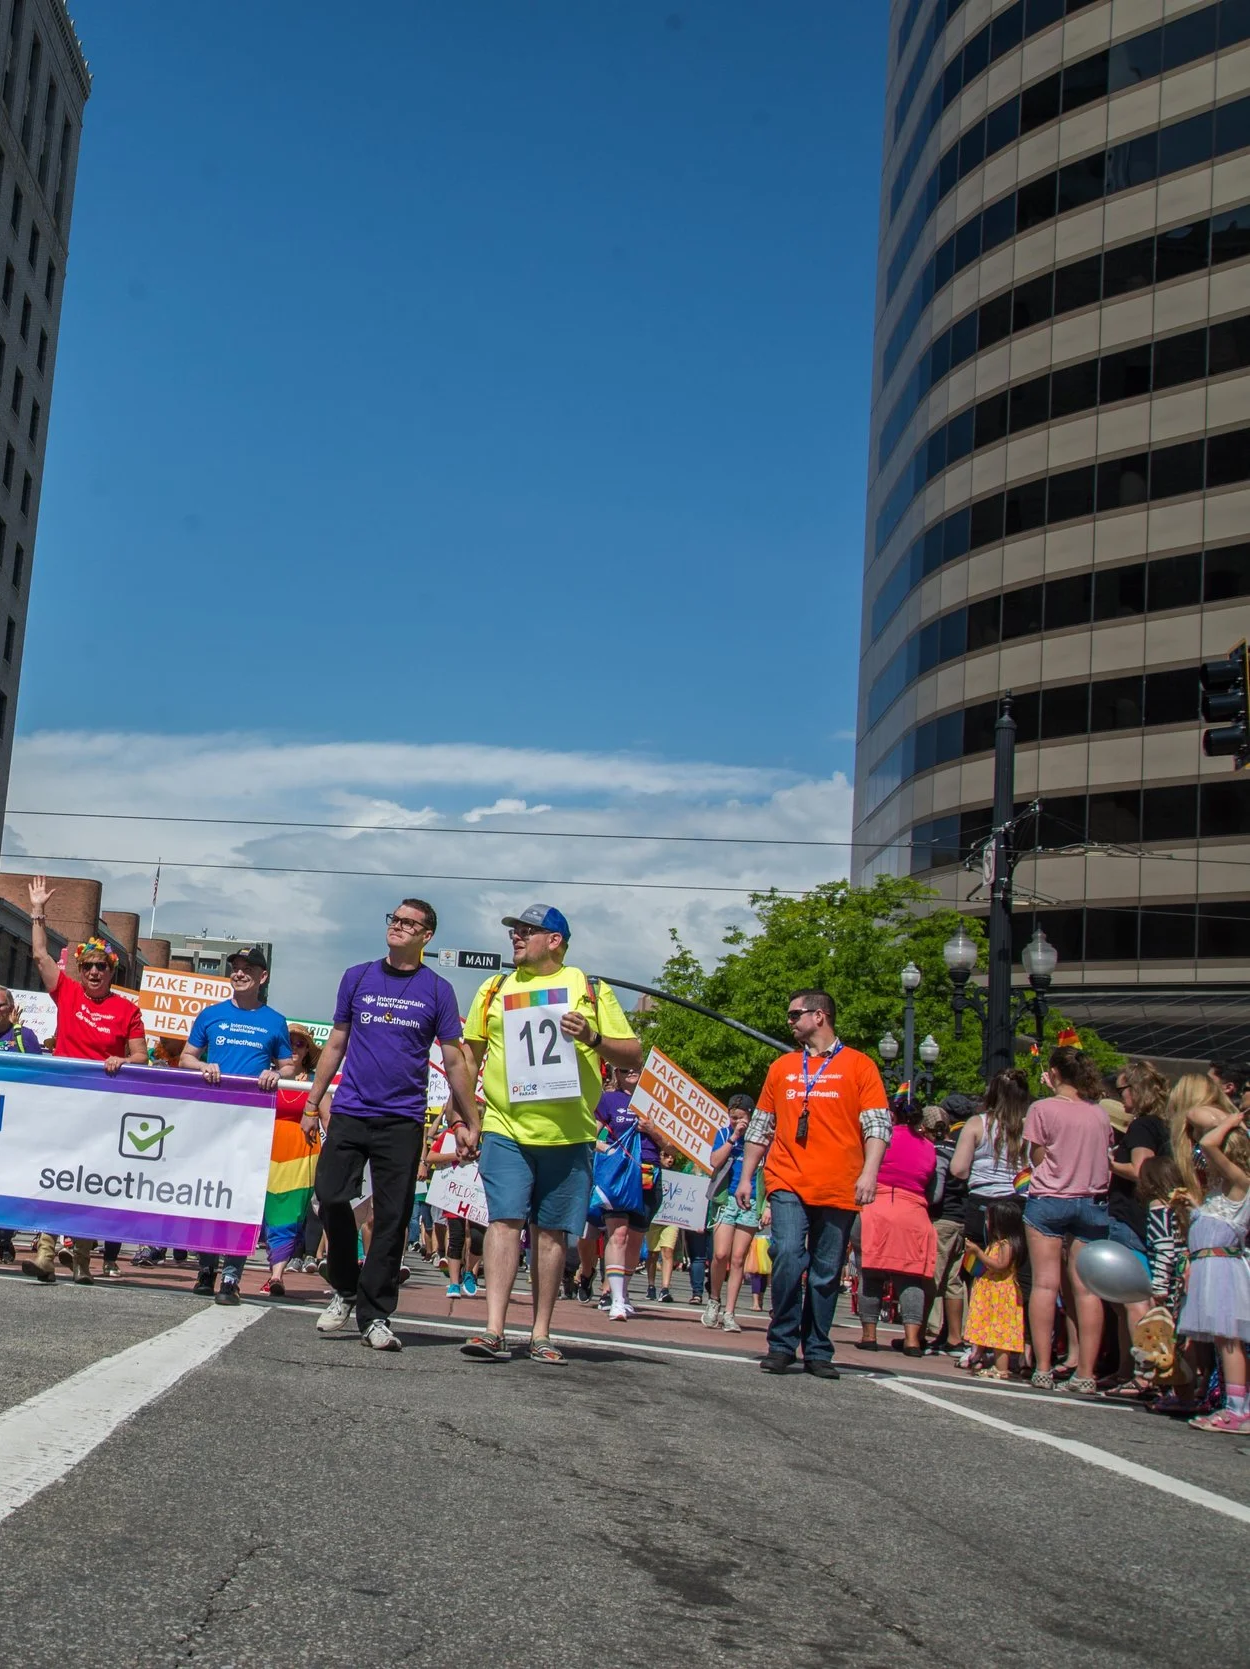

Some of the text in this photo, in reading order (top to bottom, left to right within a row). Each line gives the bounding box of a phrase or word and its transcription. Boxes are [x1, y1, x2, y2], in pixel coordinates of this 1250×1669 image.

[465, 955, 494, 967] MAIN
[145, 974, 232, 998] TAKE PRID
[154, 995, 172, 1010] IN
[378, 995, 424, 1008] Intermountain
[155, 1015, 192, 1032] HEA
[230, 1022, 268, 1034] Intermountain
[226, 1038, 264, 1050] selecthealth
[519, 1018, 561, 1067] 12
[512, 1083, 538, 1095] pride
[651, 1055, 728, 1128] TAKE PRIDE
[652, 1082, 669, 1104] IN
[673, 1097, 711, 1139] YOUR
[648, 1102, 703, 1154] HEALTH
[39, 1165, 234, 1210] selecthealth
